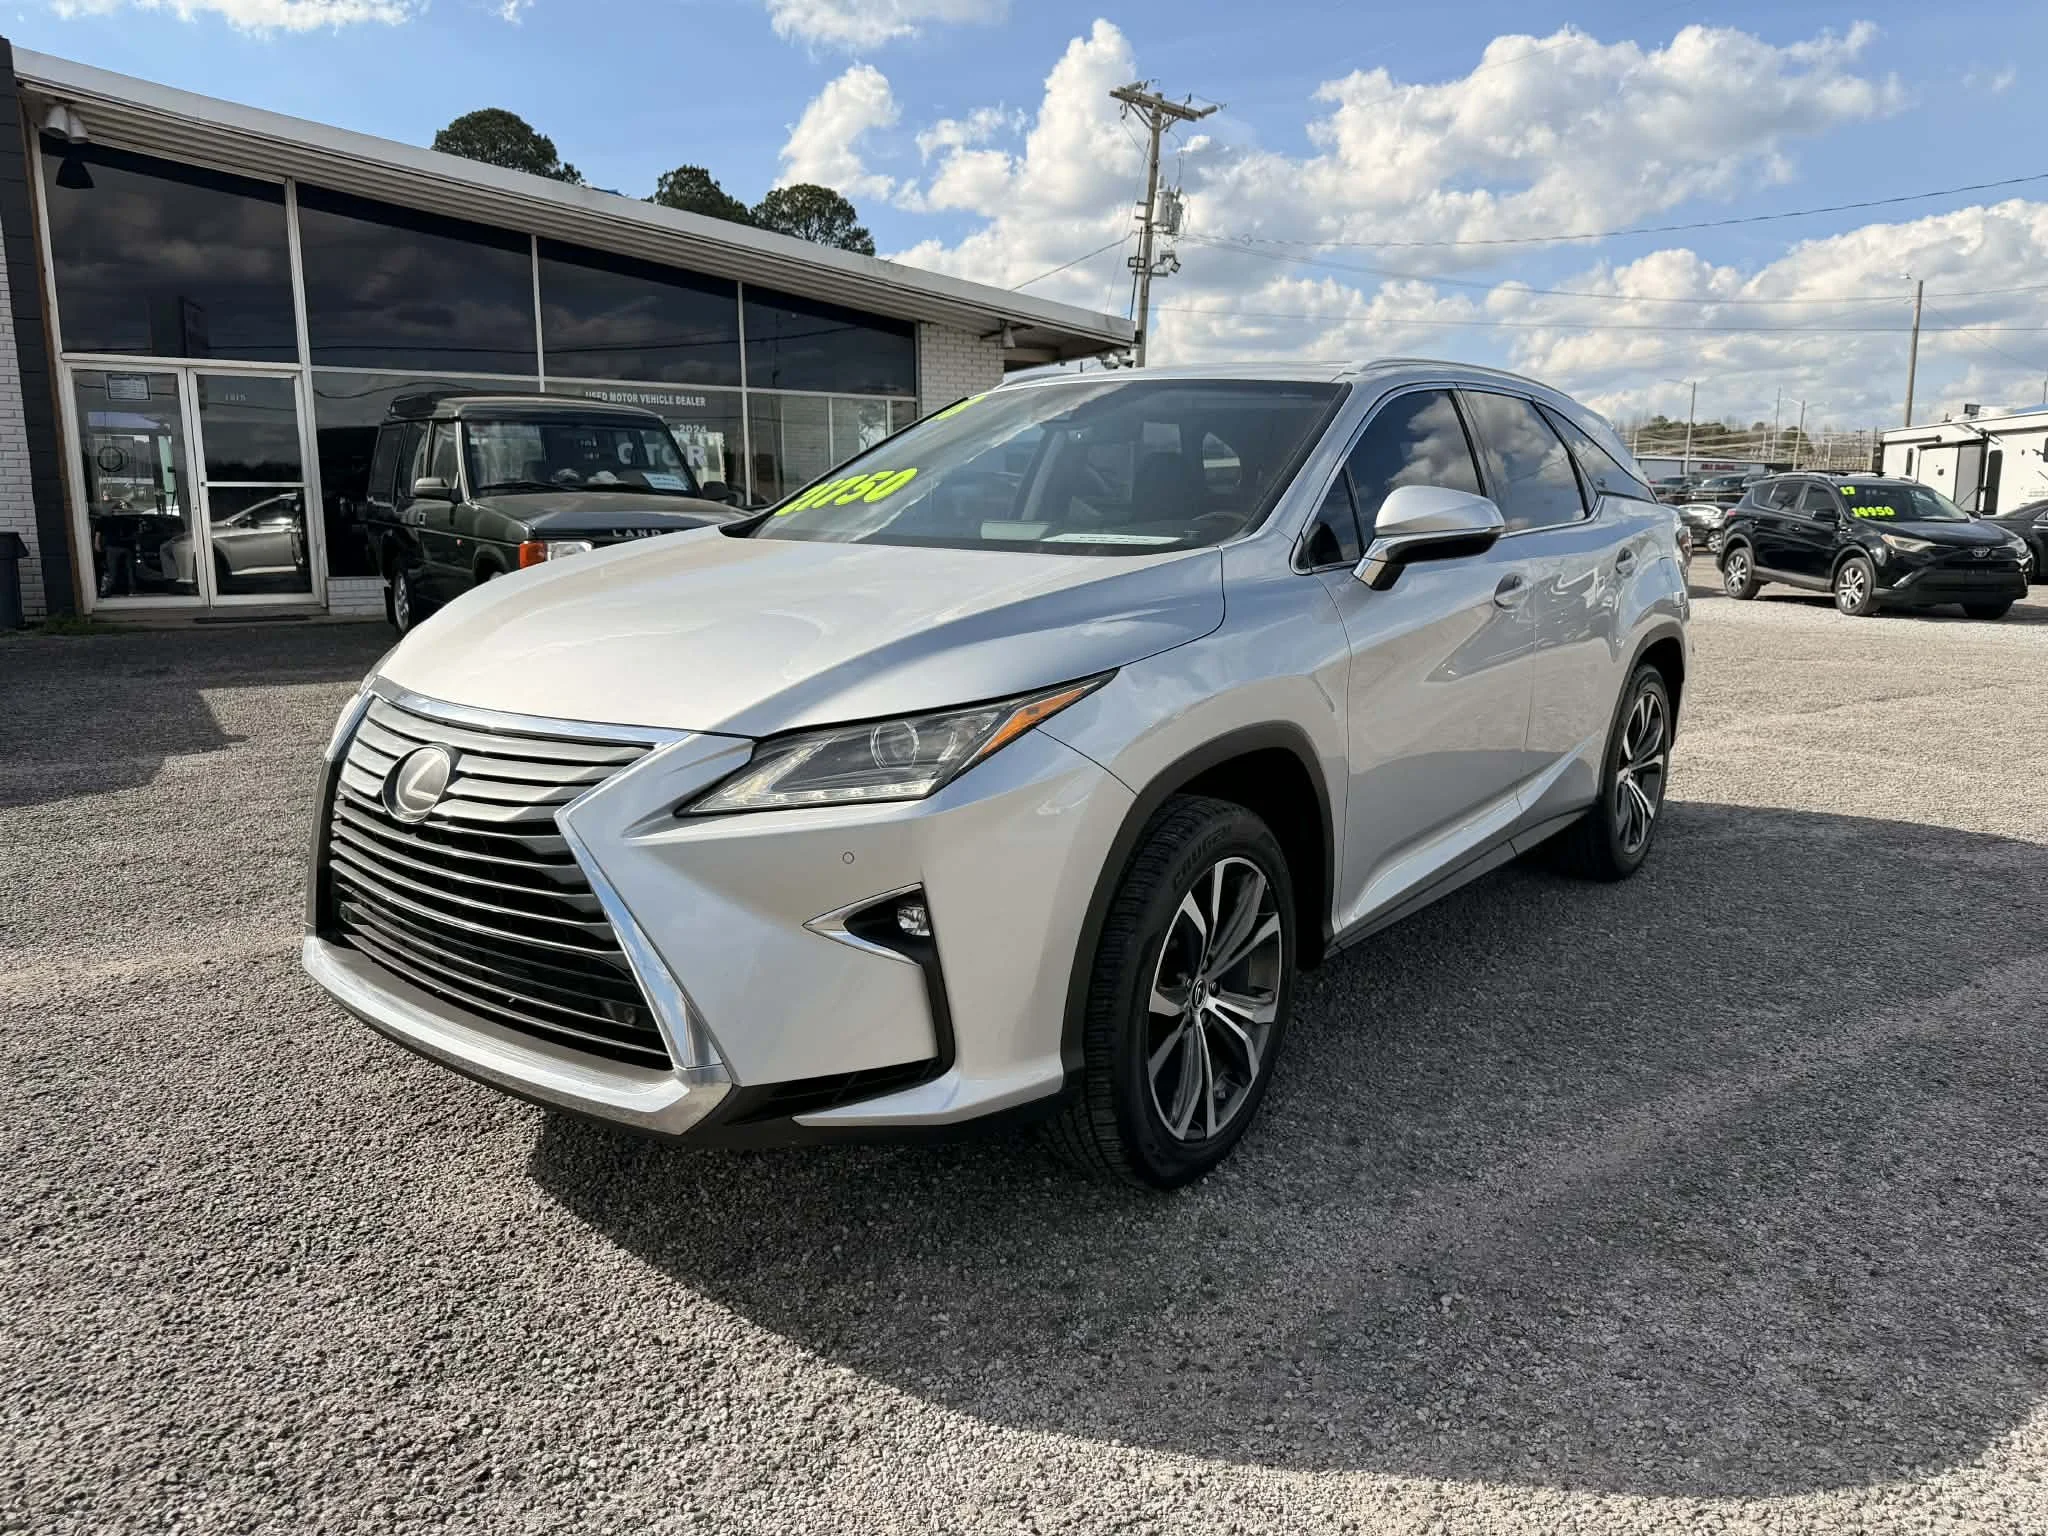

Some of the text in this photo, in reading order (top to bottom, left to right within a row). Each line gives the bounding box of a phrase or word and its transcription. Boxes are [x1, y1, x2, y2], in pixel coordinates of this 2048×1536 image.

[609, 391, 639, 403] MOTOR
[640, 393, 675, 405] VEHICLE
[675, 395, 706, 407] DEALER
[679, 423, 707, 433] 2024
[612, 528, 662, 538] LAND
